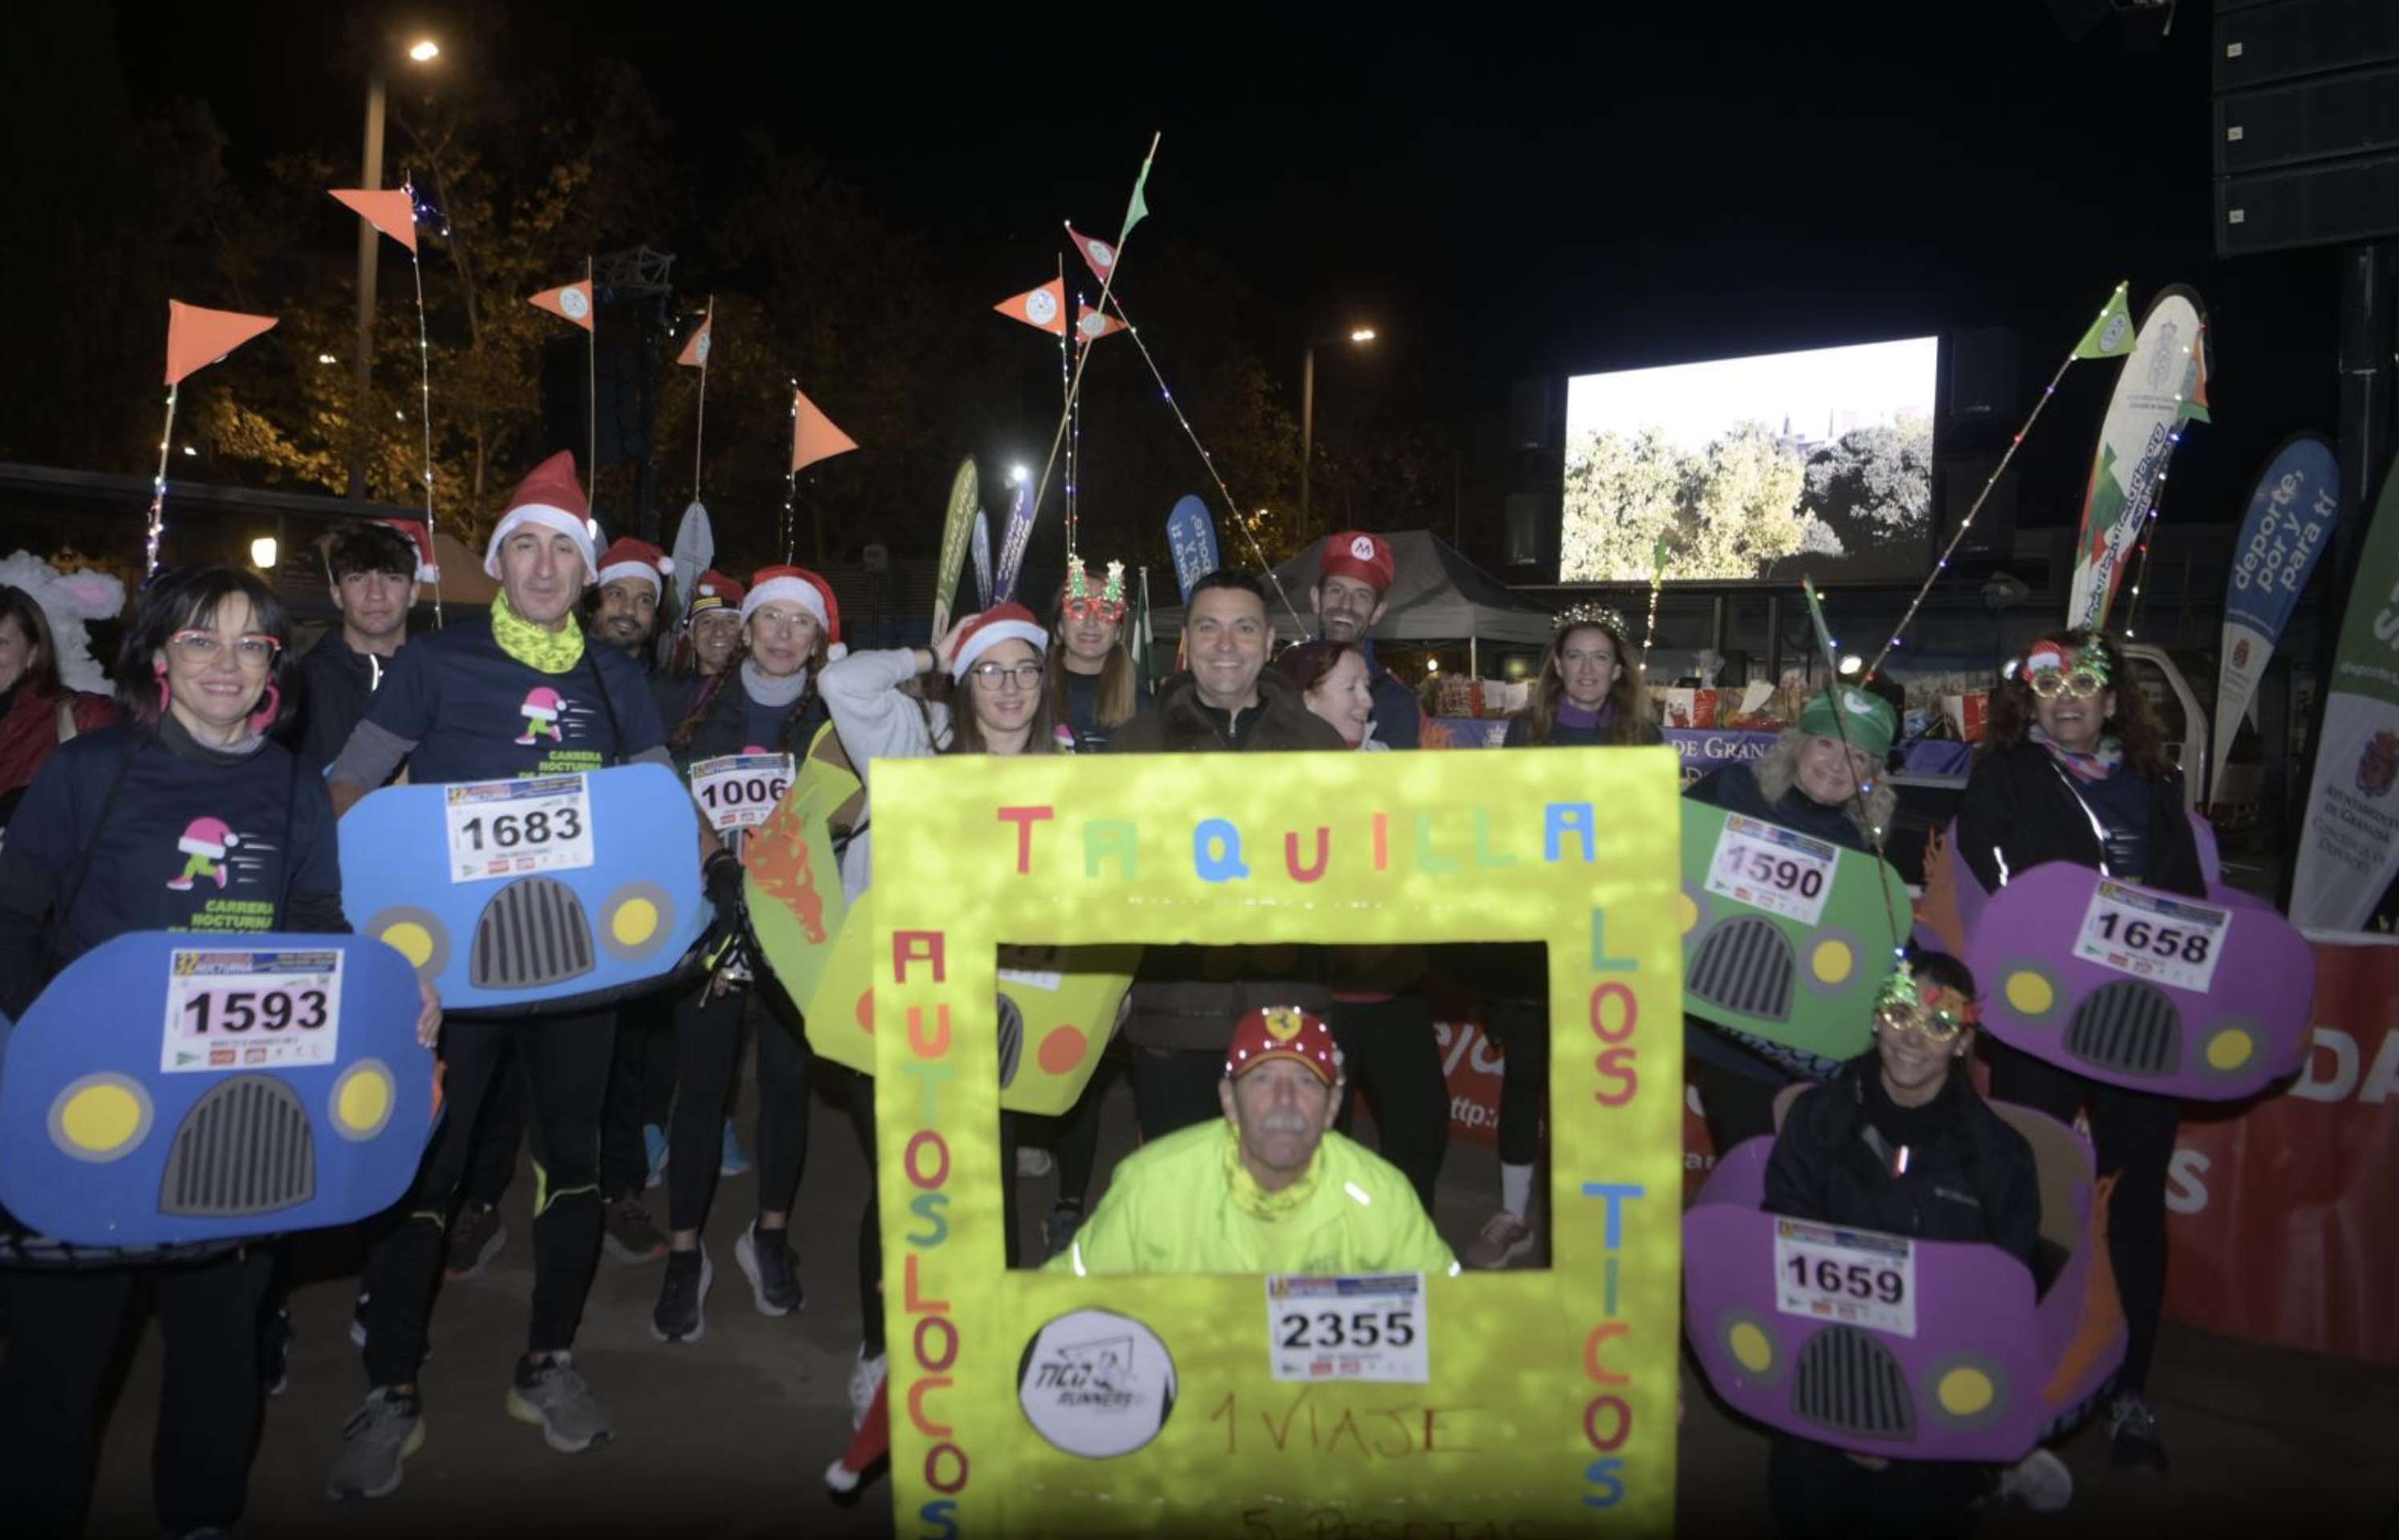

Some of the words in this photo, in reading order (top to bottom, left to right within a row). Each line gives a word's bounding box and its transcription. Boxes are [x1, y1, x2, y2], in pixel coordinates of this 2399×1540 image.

[1354, 542, 1370, 555] M
[2235, 469, 2306, 590] deporte,
[2257, 533, 2287, 594] por
[2283, 512, 2302, 538] y
[2280, 521, 2323, 592] para
[1703, 736, 1775, 760] GRAN
[701, 778, 787, 808] 1006
[462, 807, 582, 850] 1683
[997, 802, 1595, 883] TAQUILLA
[1727, 845, 1823, 899] 1590
[2099, 911, 2210, 965] 1658
[185, 990, 328, 1033] 1593
[1589, 908, 1639, 1107] LOS
[1788, 1254, 1904, 1304] 1659
[1281, 1312, 1415, 1349] 2355
[1581, 1182, 1645, 1508] TICOS
[1261, 1386, 1489, 1461] VIAJE
